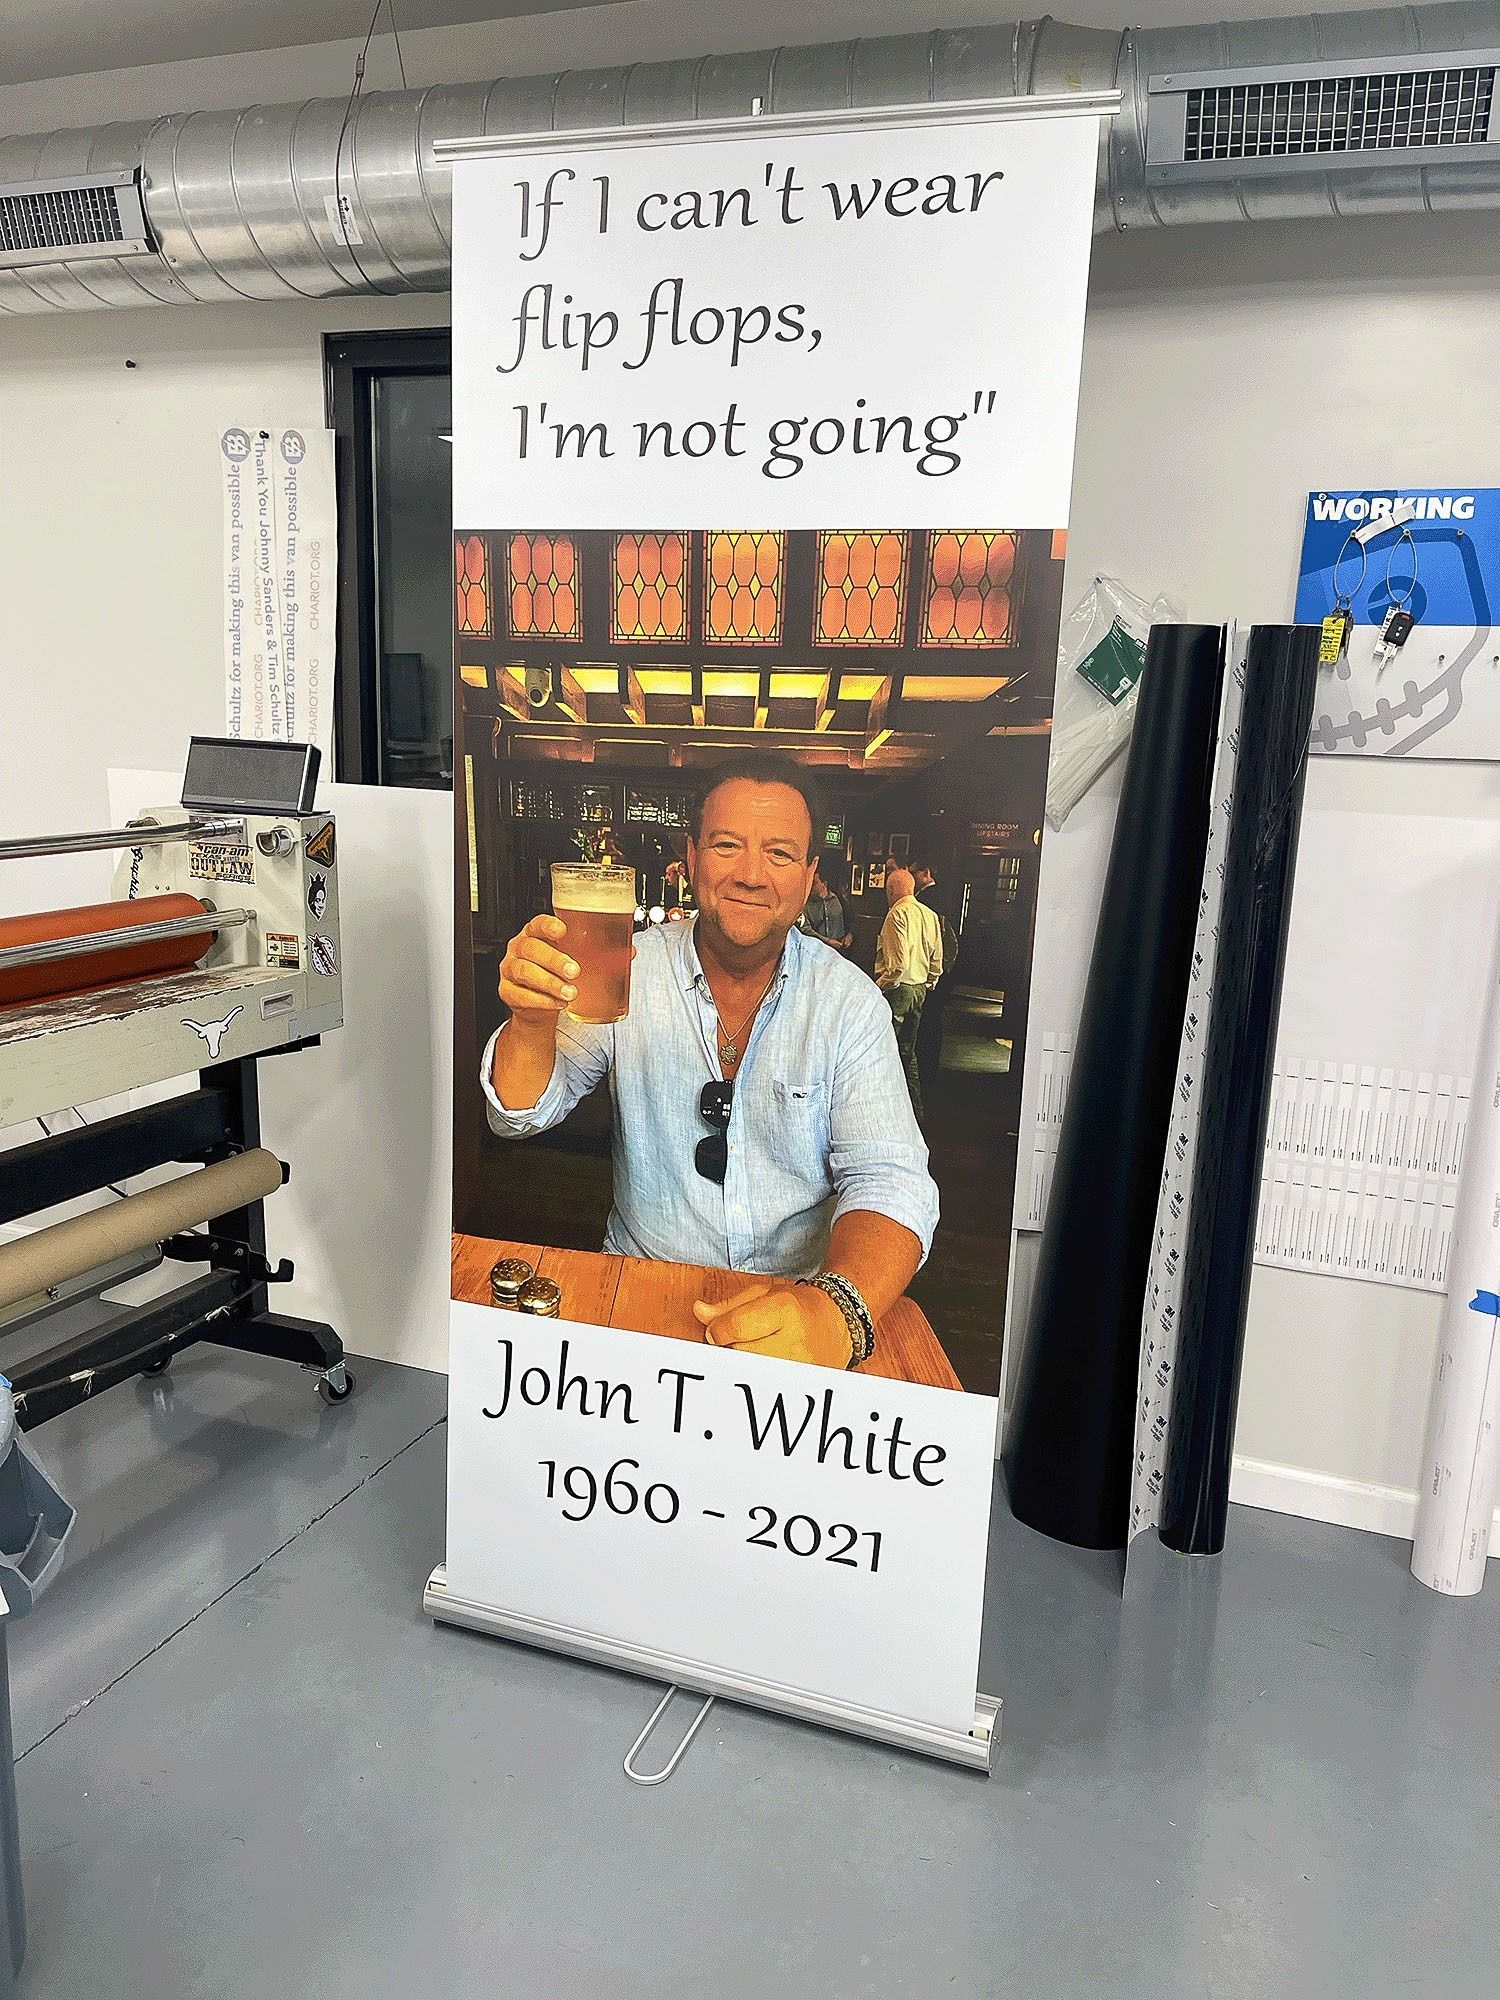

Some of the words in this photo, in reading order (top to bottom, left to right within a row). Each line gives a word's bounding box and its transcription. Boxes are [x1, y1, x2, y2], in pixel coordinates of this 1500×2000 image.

[513, 167, 575, 261] If
[593, 176, 610, 235] I
[636, 162, 804, 232] can't
[822, 169, 1004, 221] wear
[496, 284, 619, 374] flip
[622, 278, 822, 371] flops,
[513, 402, 615, 460] I'm
[633, 404, 745, 458] not
[762, 391, 998, 479] going"
[255, 439, 267, 485] Thank
[227, 464, 244, 530] possible
[258, 488, 269, 516] You
[284, 466, 300, 533] possible
[231, 534, 241, 562] van
[259, 520, 272, 574] Johnny
[286, 536, 297, 566] van
[228, 566, 241, 594] this
[283, 569, 296, 598] this
[229, 599, 244, 657] making
[263, 577, 277, 636] Sanders
[283, 602, 299, 662] making
[229, 660, 241, 682] for
[266, 640, 278, 651] &
[267, 653, 279, 680] Tim
[269, 684, 283, 735] Schultz
[191, 858, 254, 876] OUTLAW
[483, 1339, 640, 1424] John
[657, 1368, 714, 1440] T.
[735, 1383, 947, 1487] White
[538, 1458, 681, 1523] 1960
[746, 1505, 883, 1573] 2021
